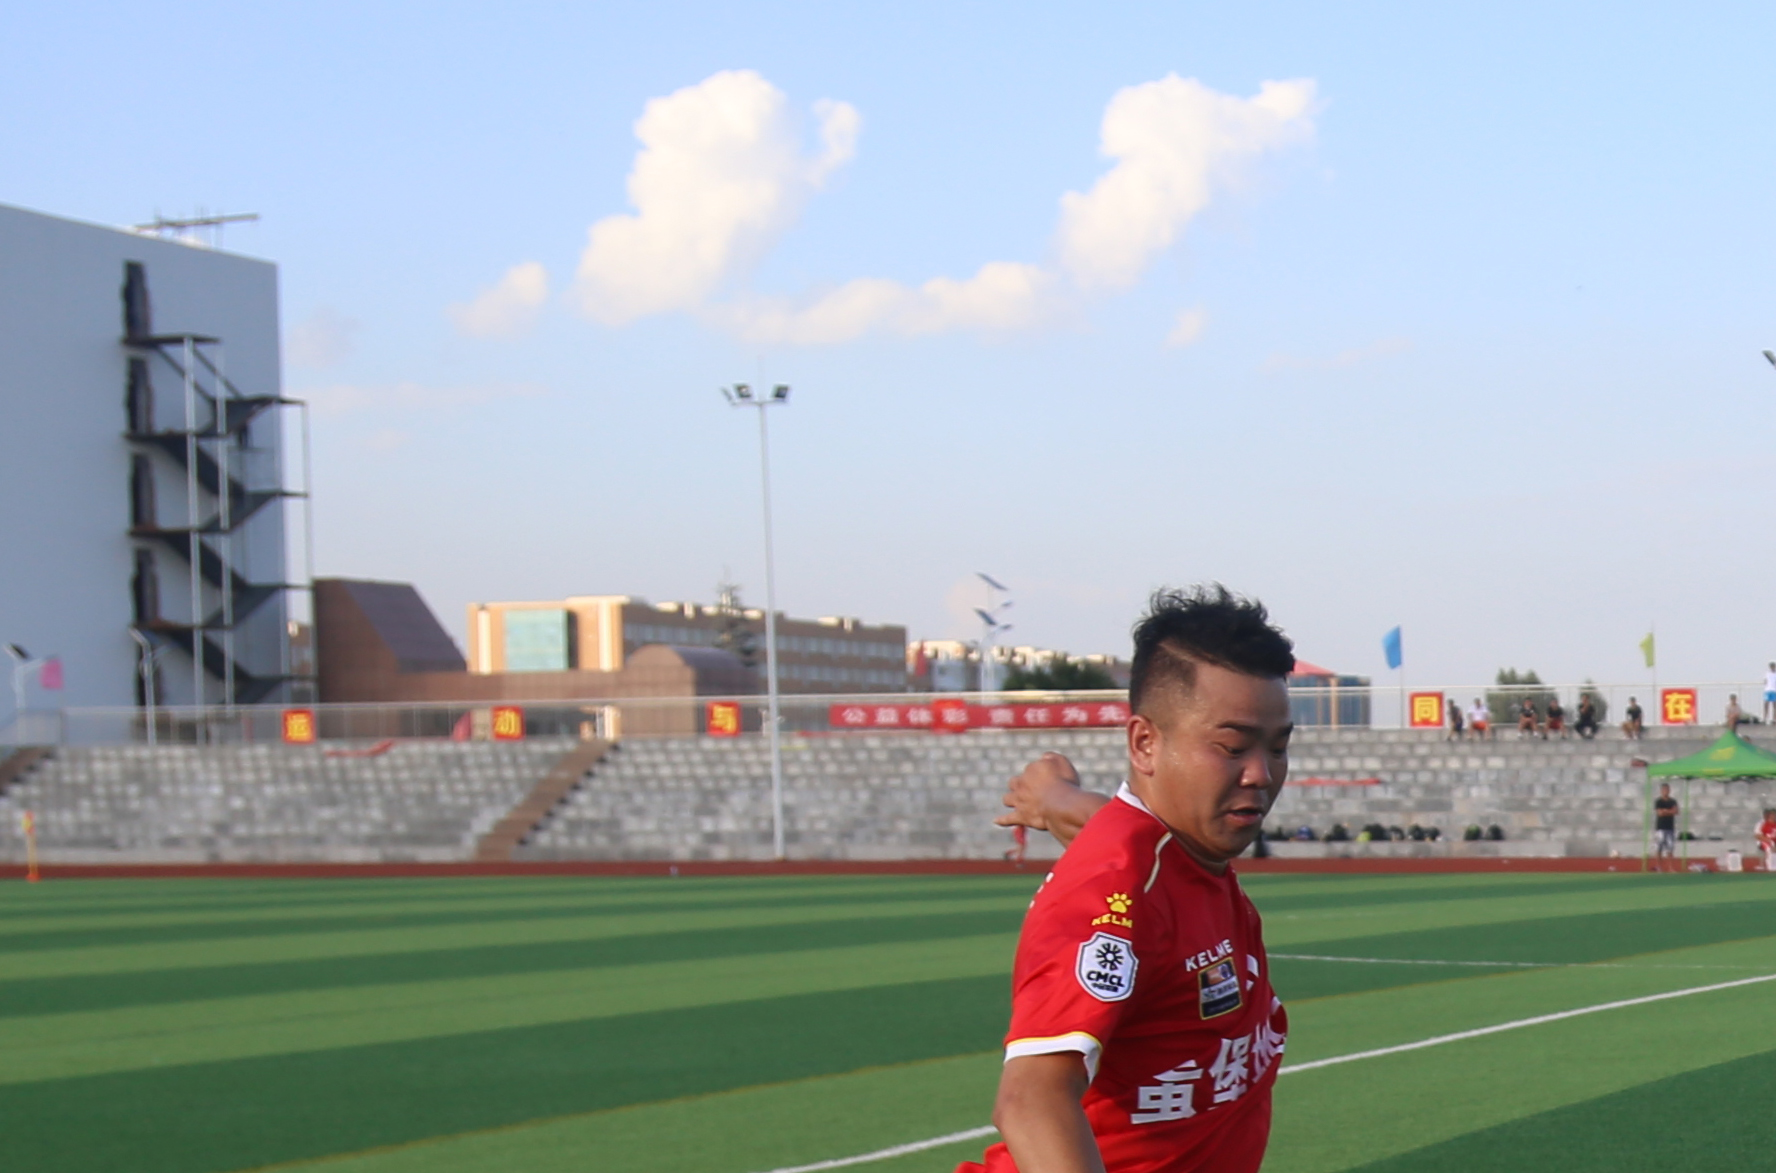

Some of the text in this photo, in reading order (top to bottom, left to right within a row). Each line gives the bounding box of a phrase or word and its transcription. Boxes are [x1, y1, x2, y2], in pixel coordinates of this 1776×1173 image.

[988, 705, 1126, 724] 责任为先
[1414, 696, 1440, 723] 同
[1665, 692, 1693, 721] 在
[287, 713, 309, 739] 运
[496, 710, 521, 736] 动
[1186, 938, 1235, 973] KELME
[1086, 969, 1126, 988] CMCL
